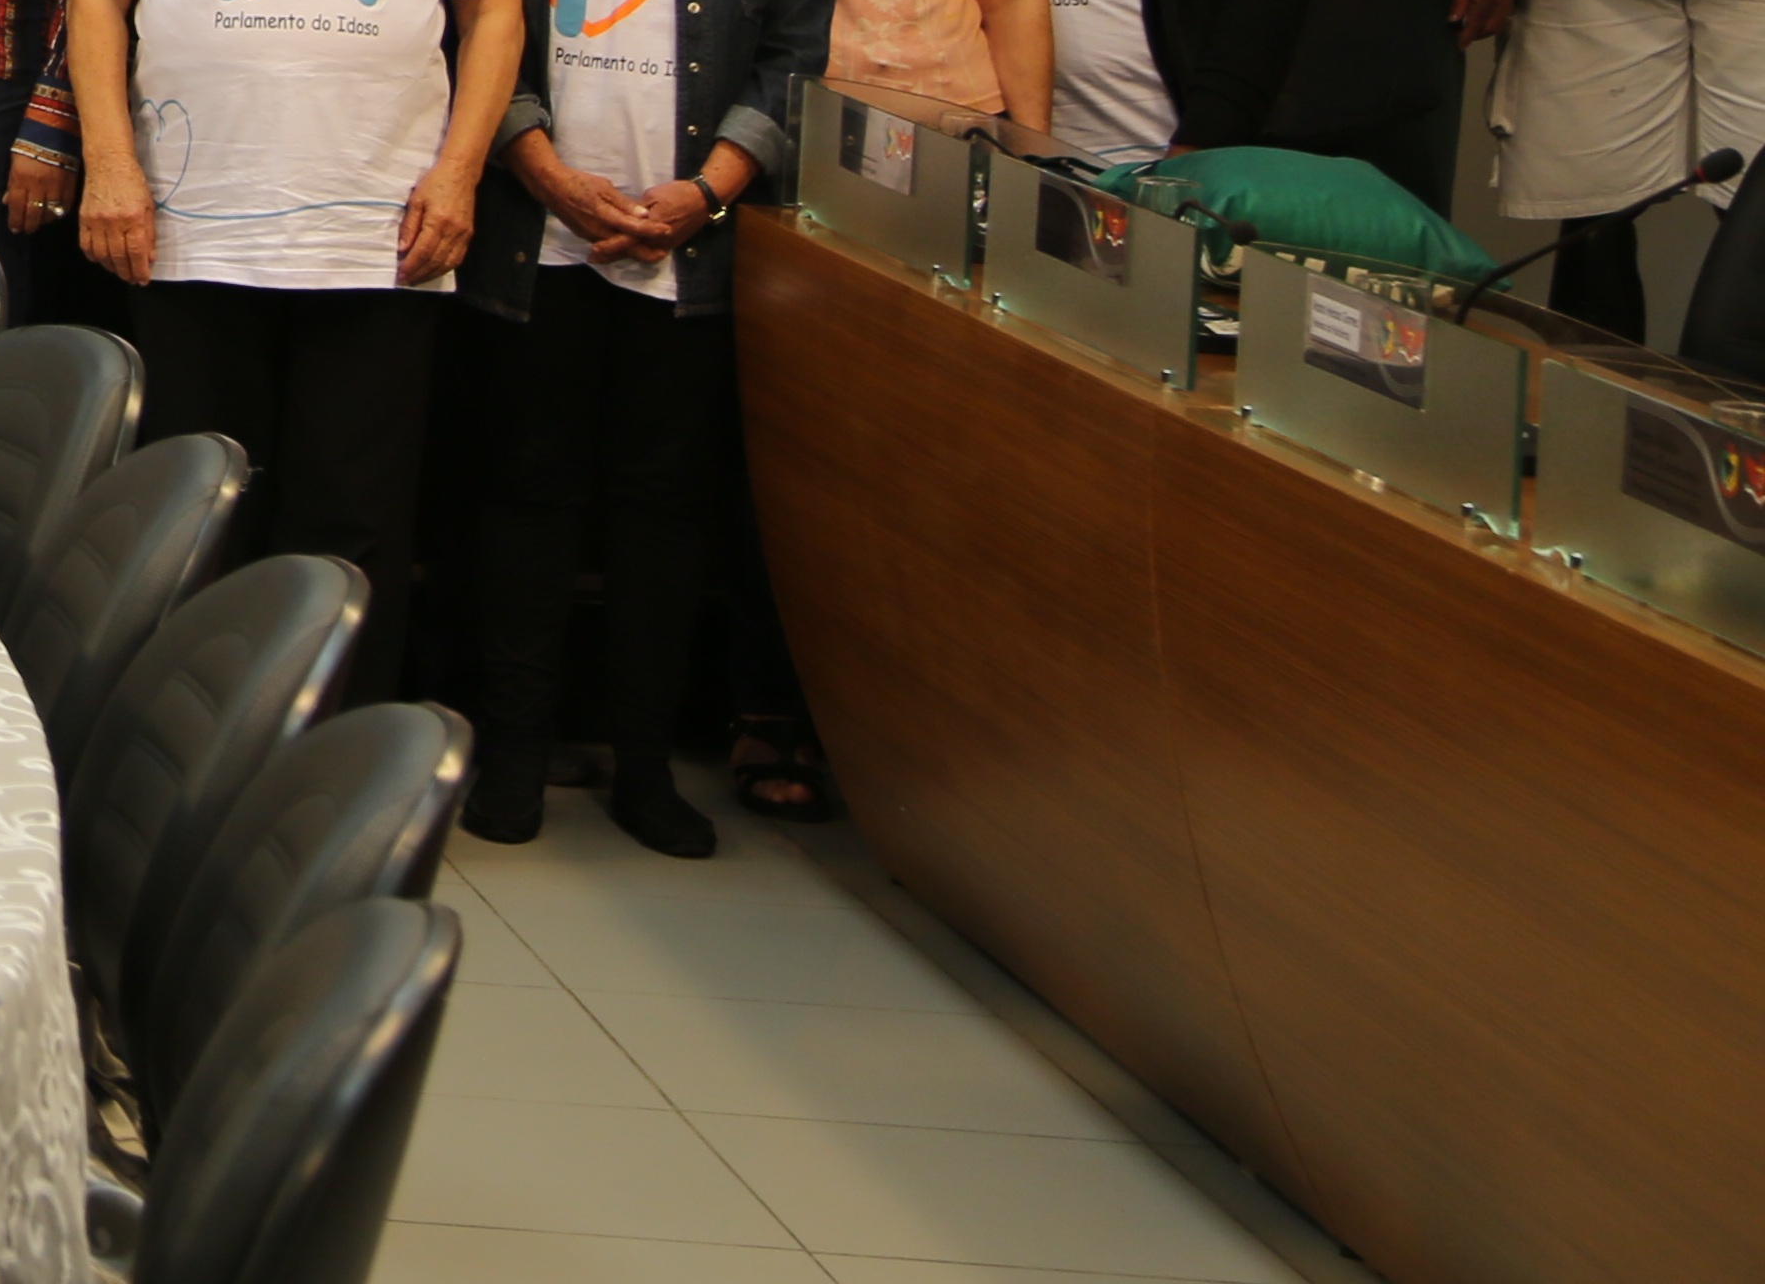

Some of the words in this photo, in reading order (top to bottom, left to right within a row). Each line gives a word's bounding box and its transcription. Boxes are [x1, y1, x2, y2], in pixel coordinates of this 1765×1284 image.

[214, 11, 306, 31] Parlamento
[312, 15, 332, 32] do
[337, 15, 380, 37] Idoso
[555, 47, 635, 72] Parlamento
[640, 58, 659, 75] do
